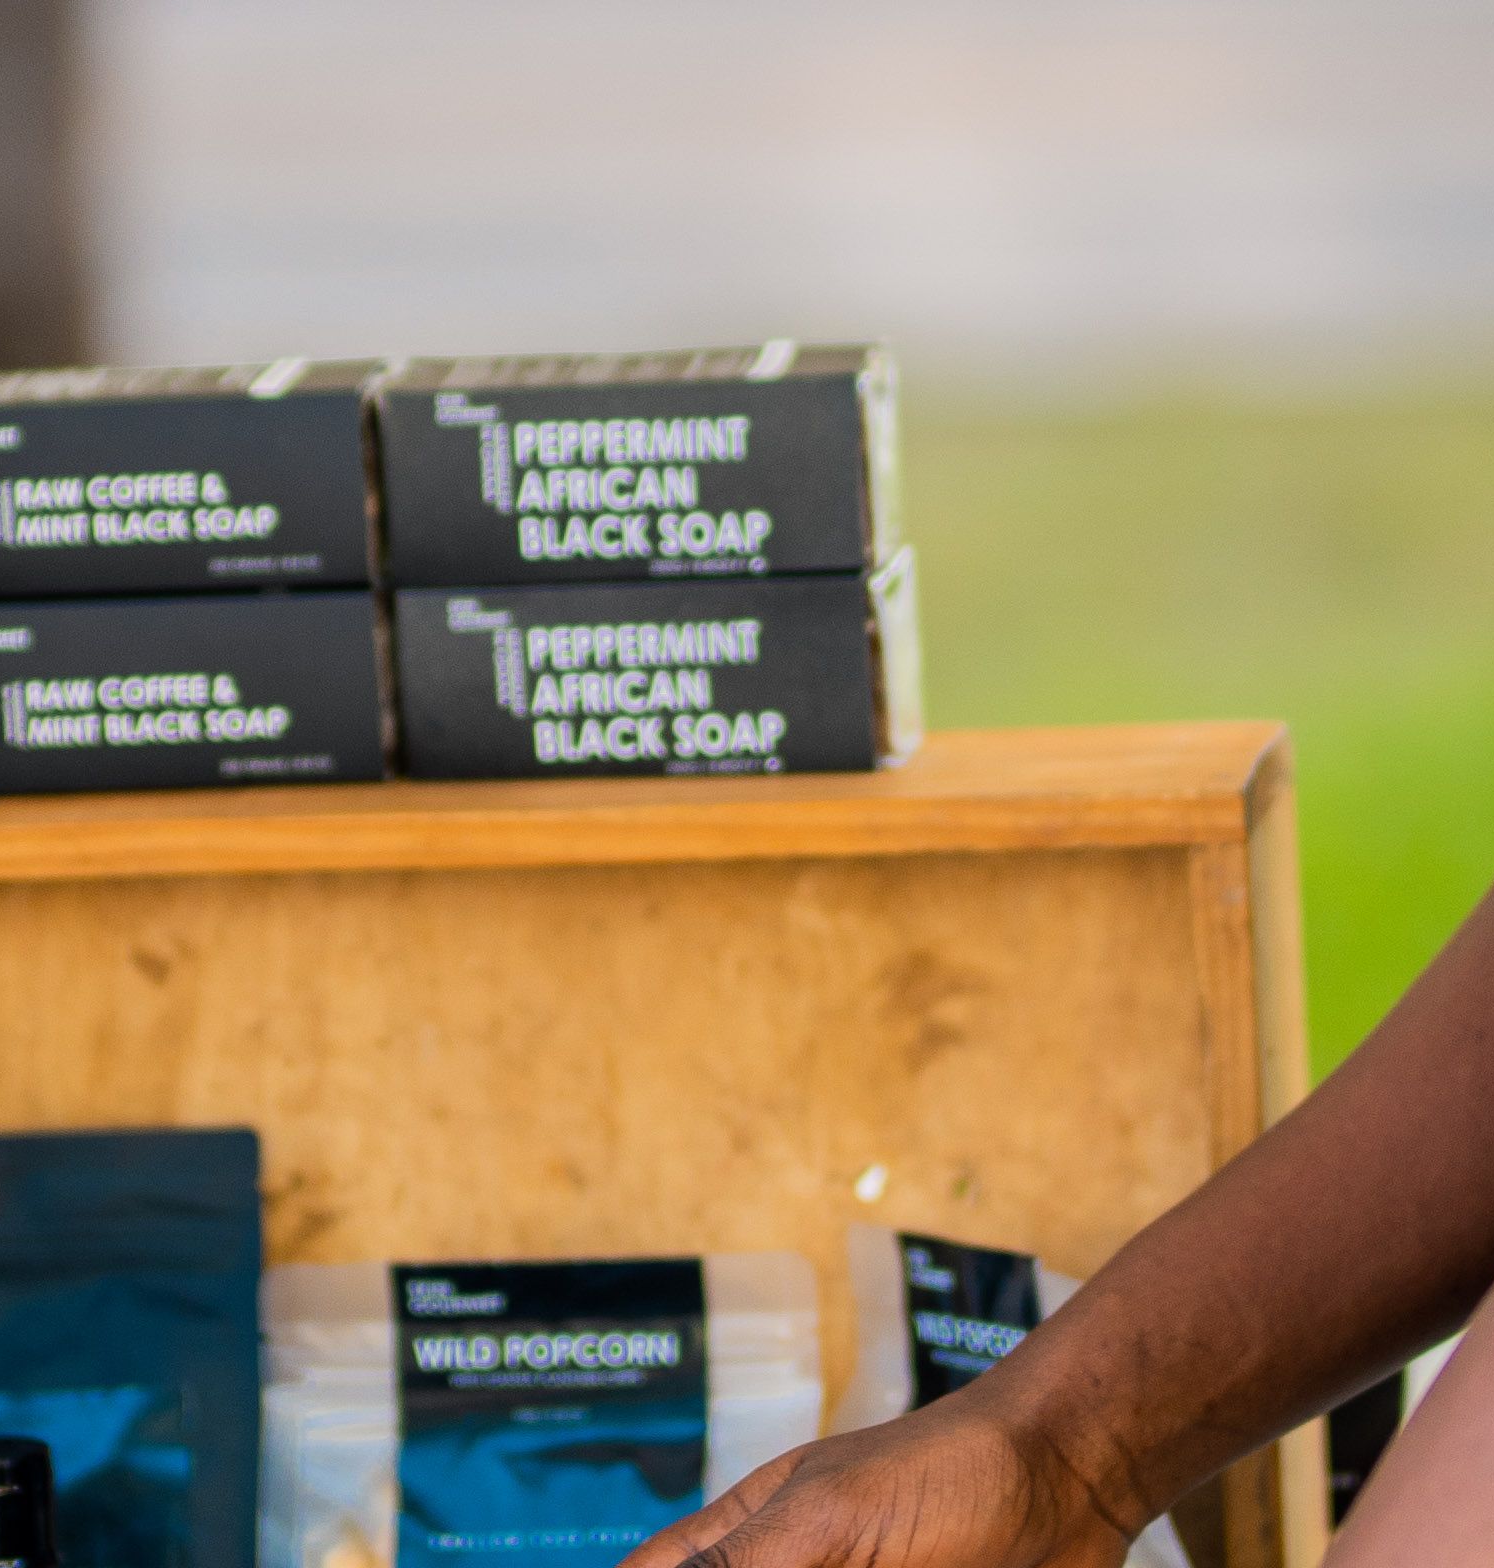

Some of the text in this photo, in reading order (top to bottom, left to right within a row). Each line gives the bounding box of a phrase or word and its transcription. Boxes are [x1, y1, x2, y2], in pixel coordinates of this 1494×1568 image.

[513, 416, 749, 463] PEPPERMINT
[14, 472, 228, 509] RAW COFFEE &
[517, 466, 698, 511] AFRICAN
[16, 504, 280, 547] MINT BLACK SOAP
[519, 511, 772, 561] BLACK SOAP
[526, 620, 762, 667] PEPPERMINT
[25, 673, 238, 710] RAW COFFEE &
[530, 669, 712, 716] AFRICAN
[27, 705, 291, 748] MINT BLACK SOAP
[533, 711, 787, 764] BLACK SOAP
[413, 1331, 682, 1370] WILD POPCORN
